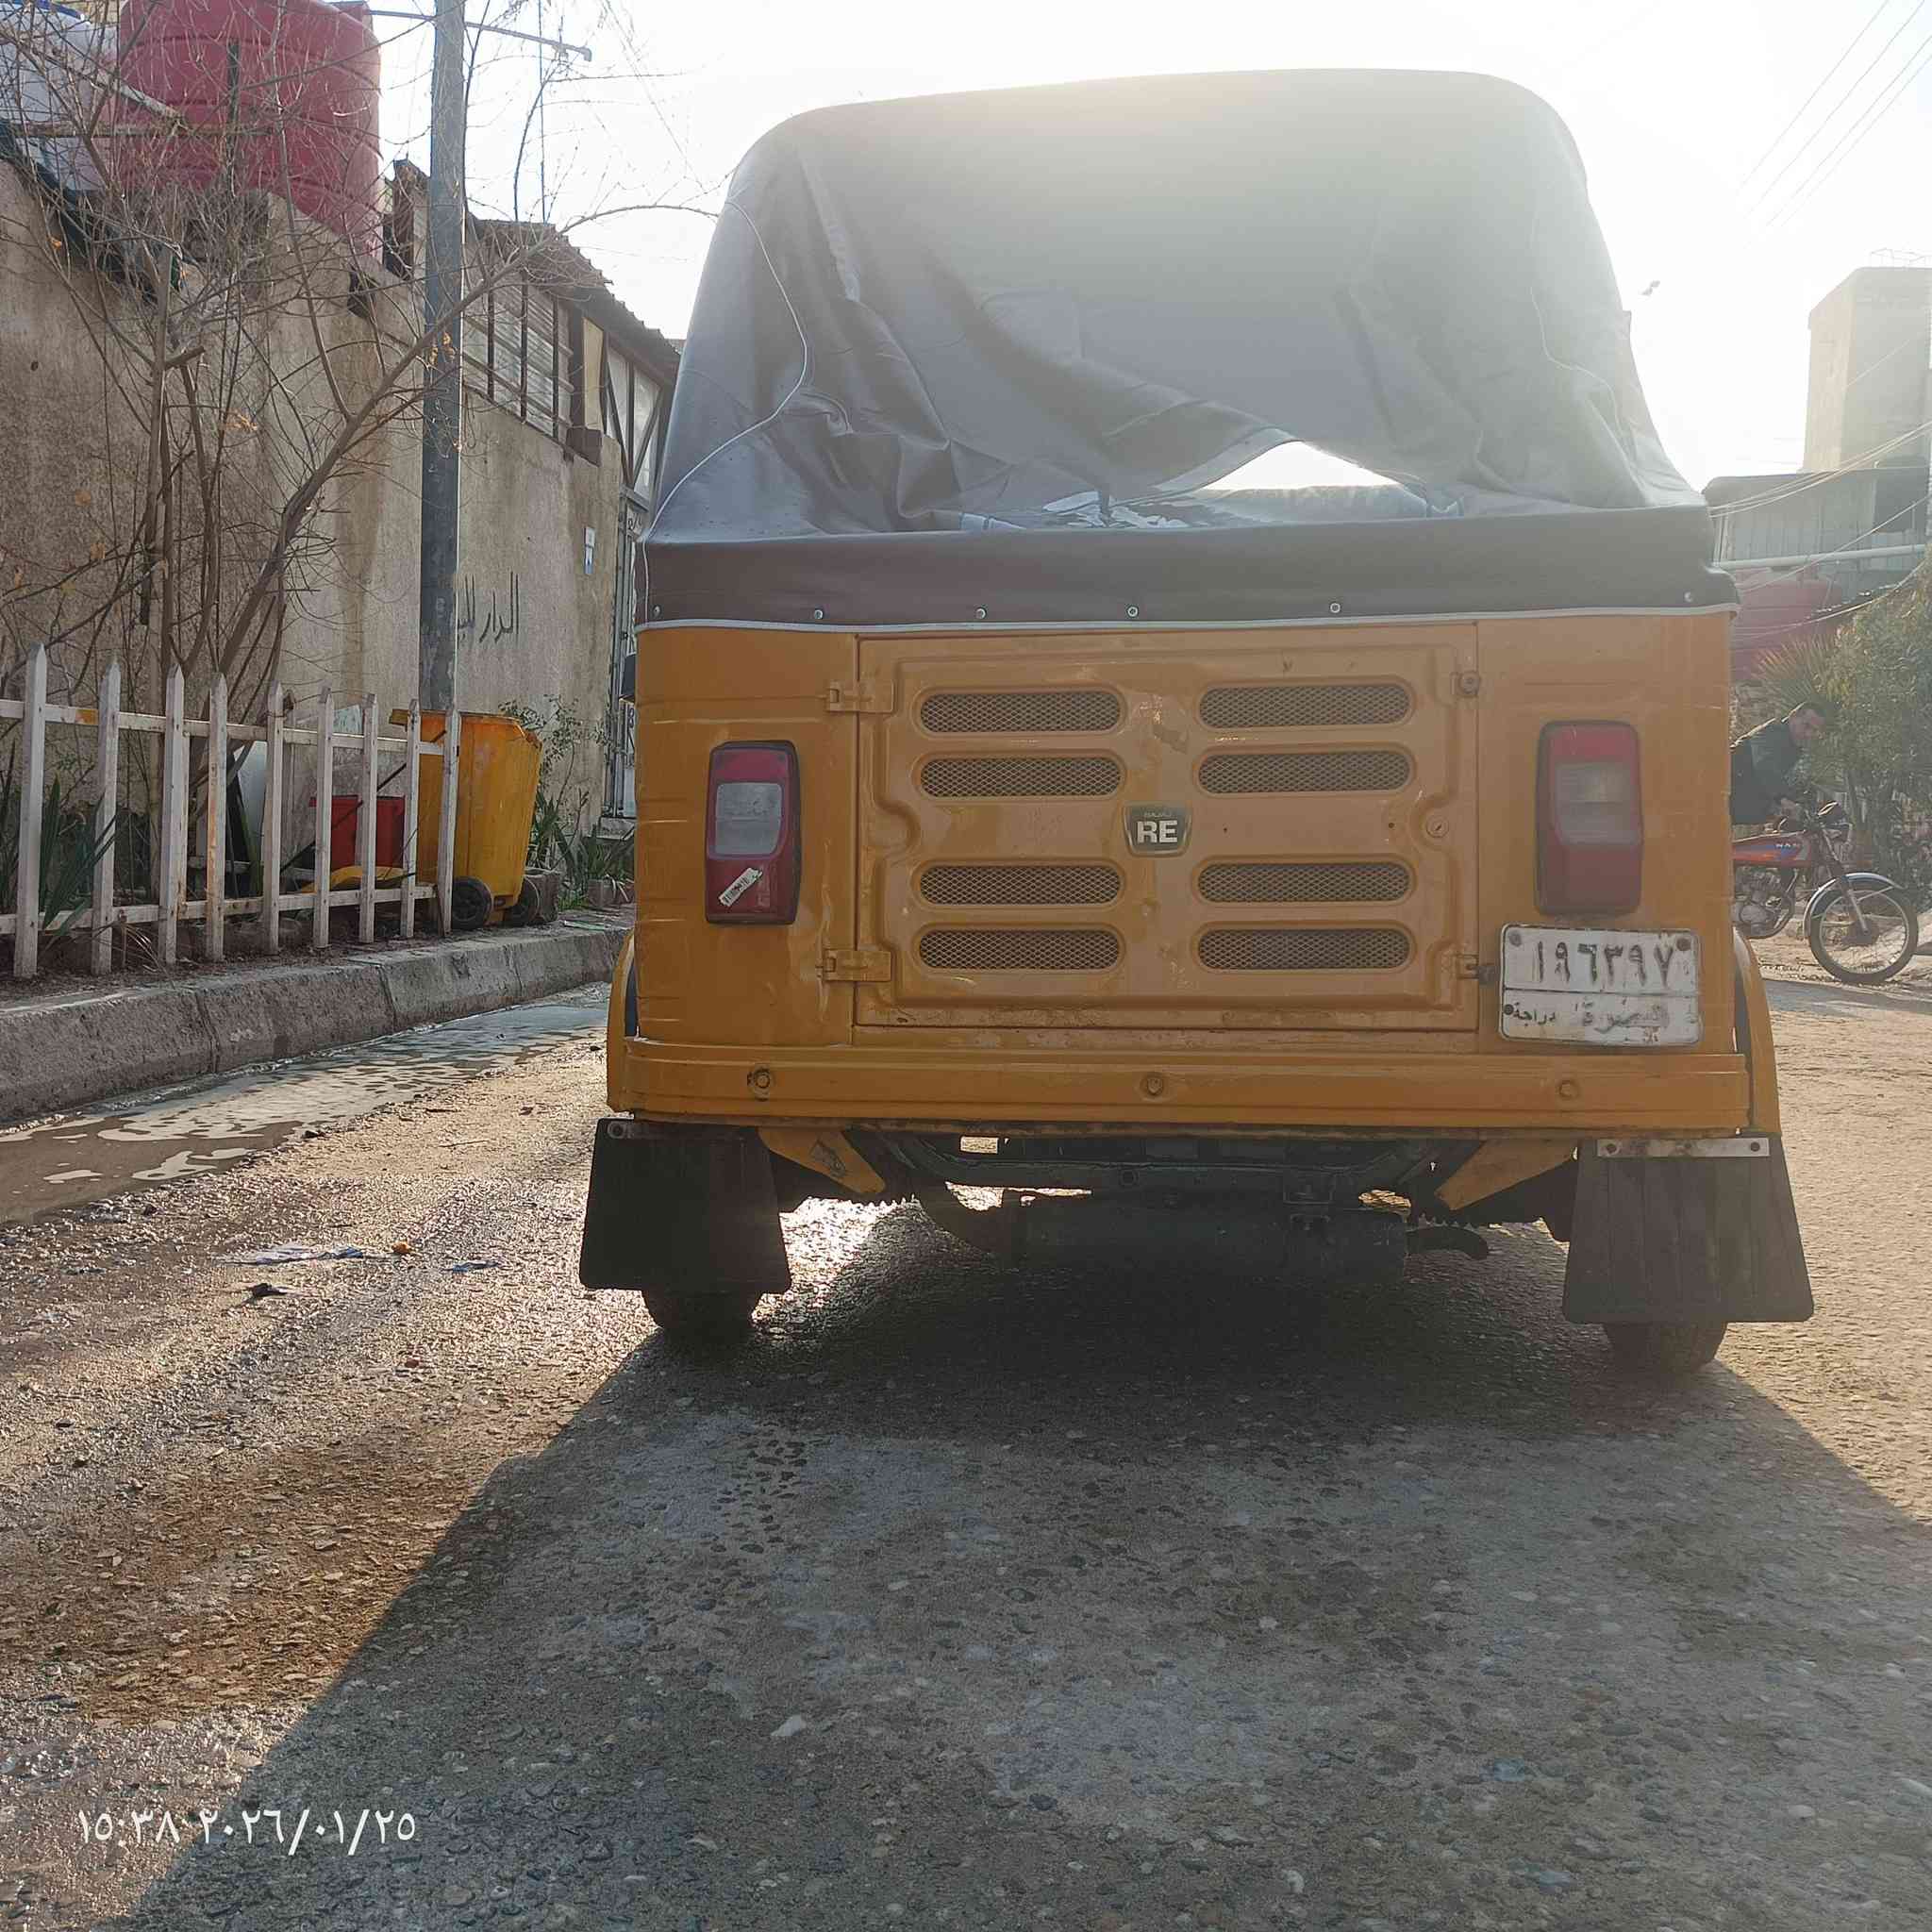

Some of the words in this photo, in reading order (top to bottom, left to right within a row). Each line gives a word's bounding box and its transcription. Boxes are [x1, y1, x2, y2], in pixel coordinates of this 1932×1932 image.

[1137, 819, 1178, 844] RE
[1537, 941, 1674, 988] ١٩٦٣٩٧
[1512, 1001, 1557, 1027] دراجة
